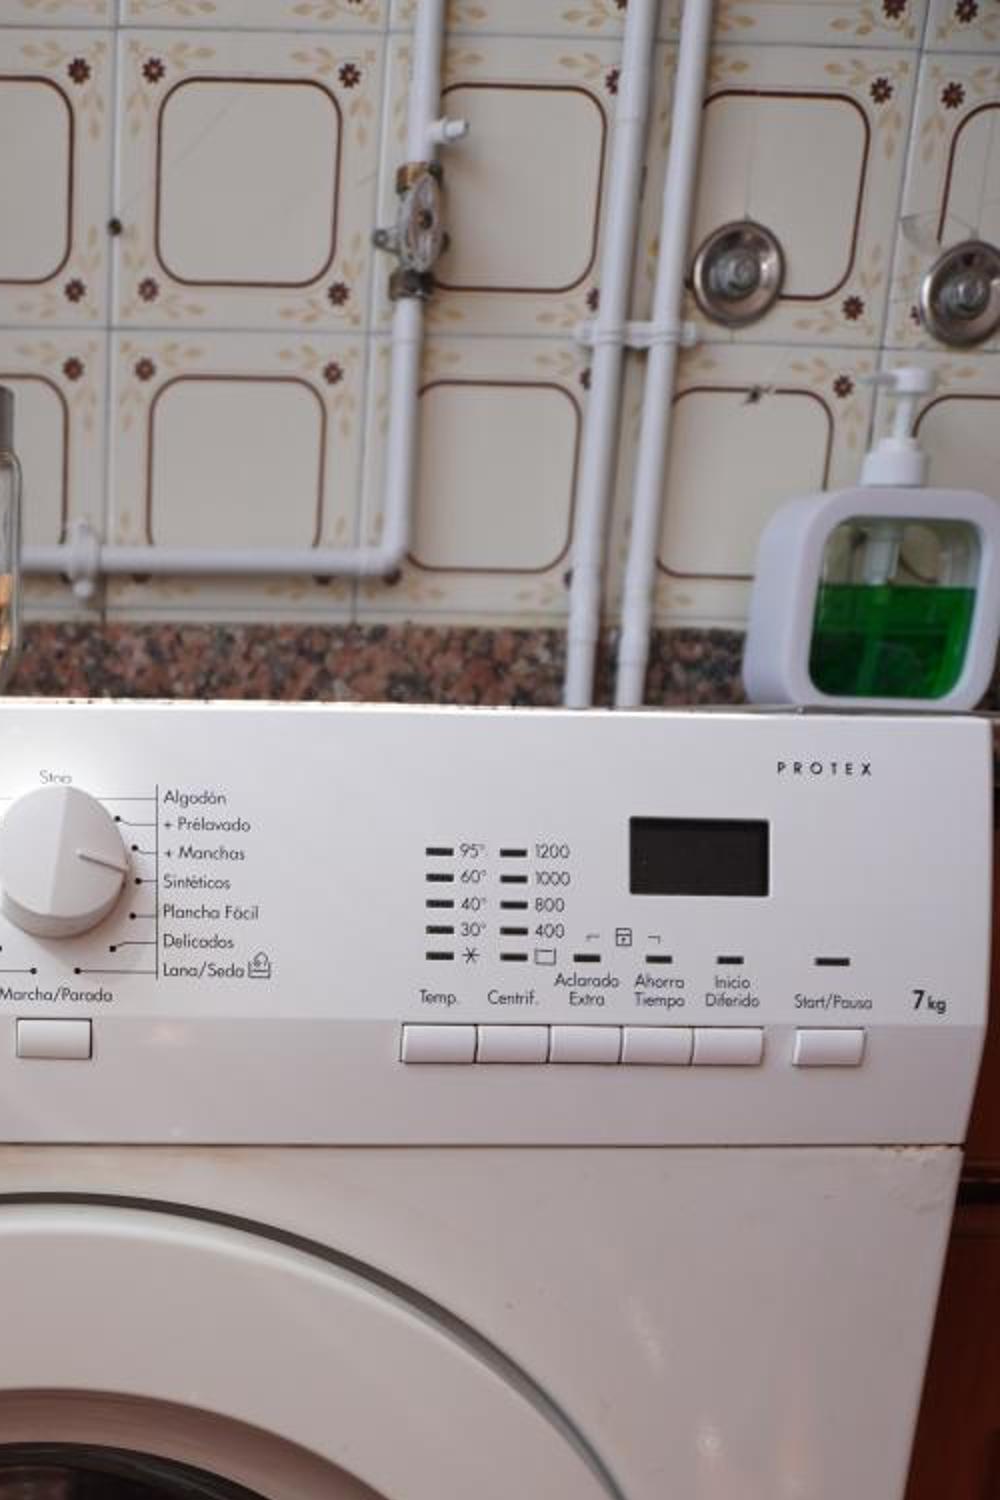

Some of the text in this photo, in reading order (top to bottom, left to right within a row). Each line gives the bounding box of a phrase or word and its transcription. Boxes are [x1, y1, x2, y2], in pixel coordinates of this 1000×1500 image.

[777, 761, 871, 776] PROTEX
[163, 789, 226, 809] Algodón
[178, 844, 245, 861] Manchas
[535, 843, 570, 859] 1200
[164, 873, 232, 890] Sintéticos
[535, 870, 571, 887] 1000
[163, 903, 259, 921] Plancha Fácil
[535, 896, 565, 913] 800
[535, 923, 565, 939] 400
[163, 933, 235, 949] Delicados
[163, 961, 245, 979] Lana/Seda
[553, 972, 620, 990] Aclarado
[634, 973, 685, 990] Ahorra
[714, 975, 751, 993] Inicio
[487, 989, 538, 1005] Centrif.
[569, 991, 605, 1007] Extra
[634, 992, 685, 1011] Tiempo
[705, 993, 760, 1008] Diferido
[794, 993, 872, 1010] Start/Pausa
[913, 989, 946, 1014] 7 kg
